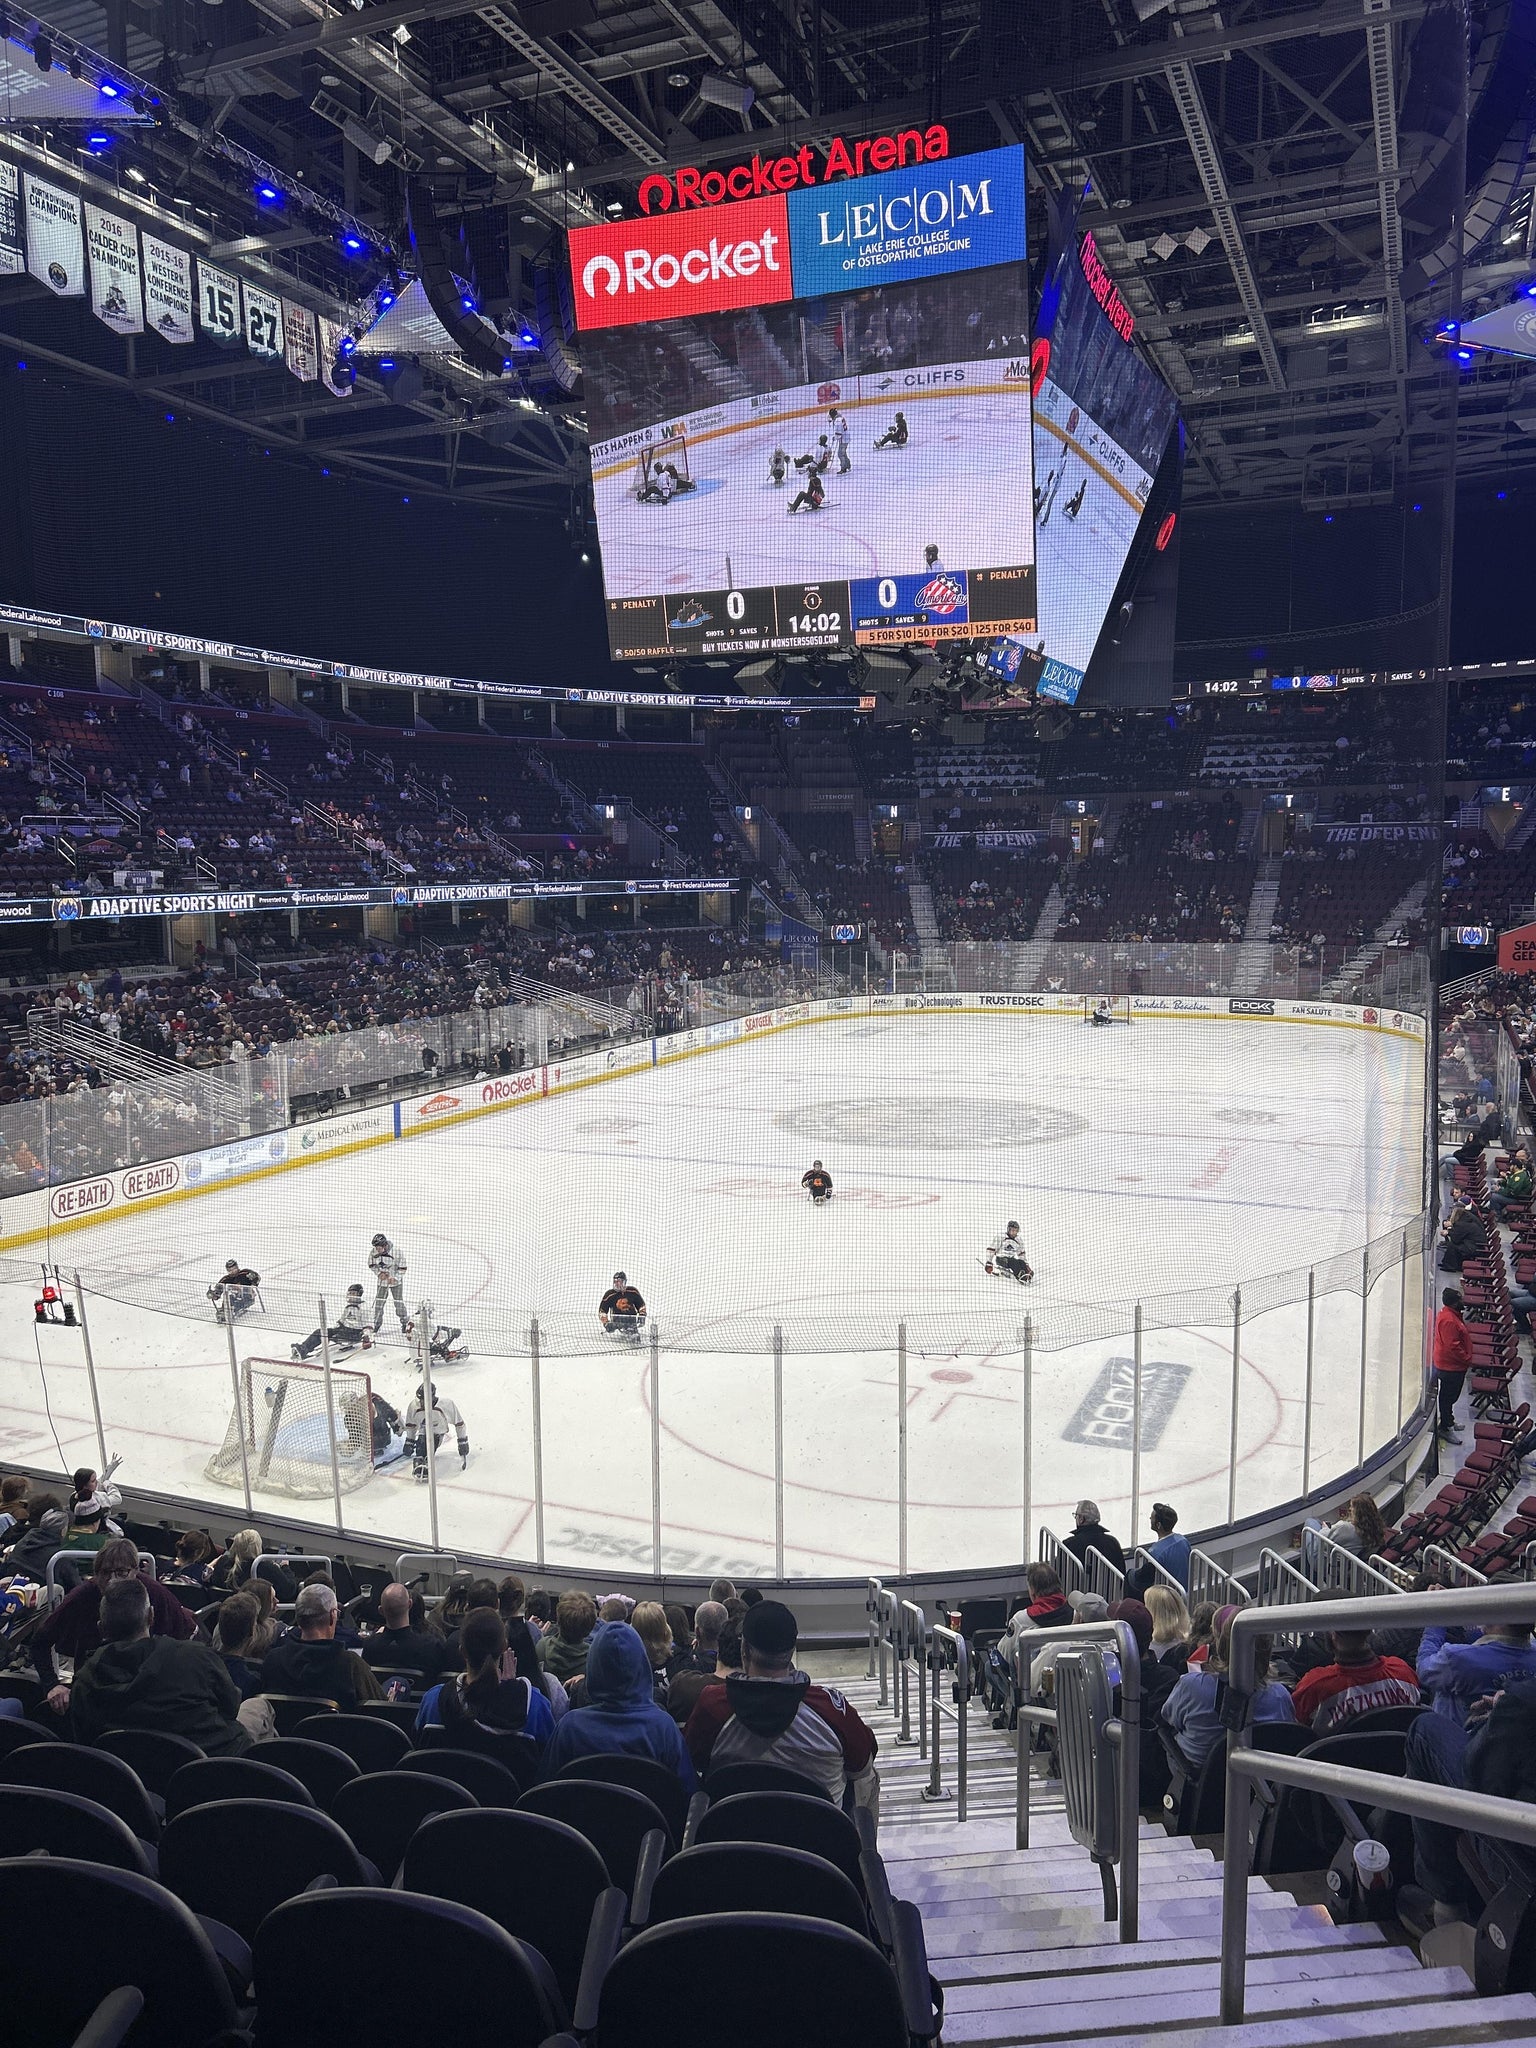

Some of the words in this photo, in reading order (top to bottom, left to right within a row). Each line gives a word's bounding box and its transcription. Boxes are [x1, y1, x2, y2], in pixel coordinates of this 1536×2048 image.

[676, 145, 816, 208] Rocket
[823, 125, 948, 181] Arena
[31, 185, 49, 201] NORTH
[50, 194, 75, 211] DIVISION
[30, 194, 77, 225] CHAMPIONS
[100, 218, 122, 236] 2016
[89, 229, 118, 252] CALDER
[120, 244, 136, 259] CUP
[859, 242, 883, 256] LAKE
[885, 238, 905, 251] ERIE
[907, 230, 949, 247] COLLEGE
[91, 246, 136, 276] CHAMPIONS
[150, 244, 183, 268] 2015-16
[624, 227, 780, 293] Rocket
[842, 259, 855, 270] OF
[857, 247, 921, 268] OSTEOPATHIC
[923, 238, 971, 257] MEDICINE
[152, 261, 184, 285] WESTERN
[148, 273, 189, 301] CONFERENCE
[1081, 239, 1114, 308] Rocket
[1105, 288, 1134, 343] Arena
[150, 288, 189, 314] CHAMPIONS
[206, 285, 234, 331] 15
[250, 306, 276, 349] 27
[904, 369, 965, 386] CLIFFS
[610, 433, 644, 452] HAPPEN
[1099, 441, 1126, 474] CLIFFS
[990, 569, 1029, 580] PENALTY
[878, 579, 897, 608] 0
[623, 599, 657, 609] PENALTY
[726, 591, 745, 620] 0
[25, 609, 62, 626] Lakewood
[789, 612, 841, 633] 14:02
[859, 618, 878, 626] SHOTS
[869, 633, 875, 641] 5
[877, 631, 894, 640] FOR
[896, 629, 912, 640] $10
[918, 628, 929, 638] 50
[932, 627, 949, 637] FOR
[951, 625, 969, 636] $20
[976, 624, 991, 634] 125
[993, 622, 1011, 633] FOR
[1013, 621, 1032, 632] $40
[111, 625, 163, 647] ADAPTIVE
[165, 634, 204, 652] SPORTS
[205, 641, 234, 657] NIGHT
[702, 642, 715, 653] BUY
[716, 640, 744, 652] TICKETS
[745, 639, 760, 650] NOW
[761, 638, 769, 649] AT
[624, 649, 646, 658] 50/50
[647, 646, 675, 656] RAFFLE
[269, 654, 280, 663] First
[280, 655, 299, 665] Federal
[298, 659, 323, 670] Lakewood
[350, 667, 388, 682] ADAPTIVE
[389, 673, 423, 686] SPORTS
[425, 677, 451, 689] NIGHT
[1292, 676, 1300, 688] 0
[1342, 675, 1364, 684] SHOTS
[1370, 673, 1377, 682] 7
[1391, 672, 1413, 681] SAVES
[1418, 670, 1426, 679] 9
[484, 684, 495, 692] First
[495, 685, 514, 693] Federal
[515, 686, 541, 695] Lakewood
[1205, 681, 1238, 693] 14:02
[587, 691, 629, 703] ADAPTIVE
[630, 694, 666, 704] SPORTS
[667, 695, 695, 705] NIGHT
[744, 698, 763, 706] Federal
[1285, 795, 1294, 808] T
[1502, 787, 1511, 802] E
[605, 805, 614, 819] M
[890, 805, 898, 818] N
[1078, 801, 1086, 813] S
[934, 835, 962, 847] THE
[976, 834, 1003, 847] EEP
[1006, 833, 1037, 846] END
[1326, 827, 1357, 843] THE
[1408, 826, 1441, 842] END
[413, 888, 456, 901] ADAPTIVE
[456, 886, 487, 899] SPORTS
[488, 885, 512, 898] NIGHT
[540, 885, 549, 893] First
[682, 881, 702, 889] Federal
[90, 897, 161, 915] ADAPTIVE
[164, 895, 215, 913] SPORTS
[218, 894, 256, 911] NIGHT
[259, 896, 281, 904] Presented
[281, 896, 288, 904] by
[302, 893, 316, 903] First
[316, 892, 339, 902] Federal
[339, 891, 370, 902] Lakewood
[783, 935, 819, 943] LECOM
[979, 996, 1044, 1007] TRUSTEDSEC
[1133, 999, 1169, 1009] Sandals
[1174, 1000, 1210, 1010] Beaches
[1292, 1006, 1305, 1015] FAN
[1307, 1007, 1332, 1017] SALUTE
[495, 1073, 537, 1101] Rocket
[318, 1125, 350, 1140] MEDICAL
[351, 1118, 380, 1133] MUTUAL
